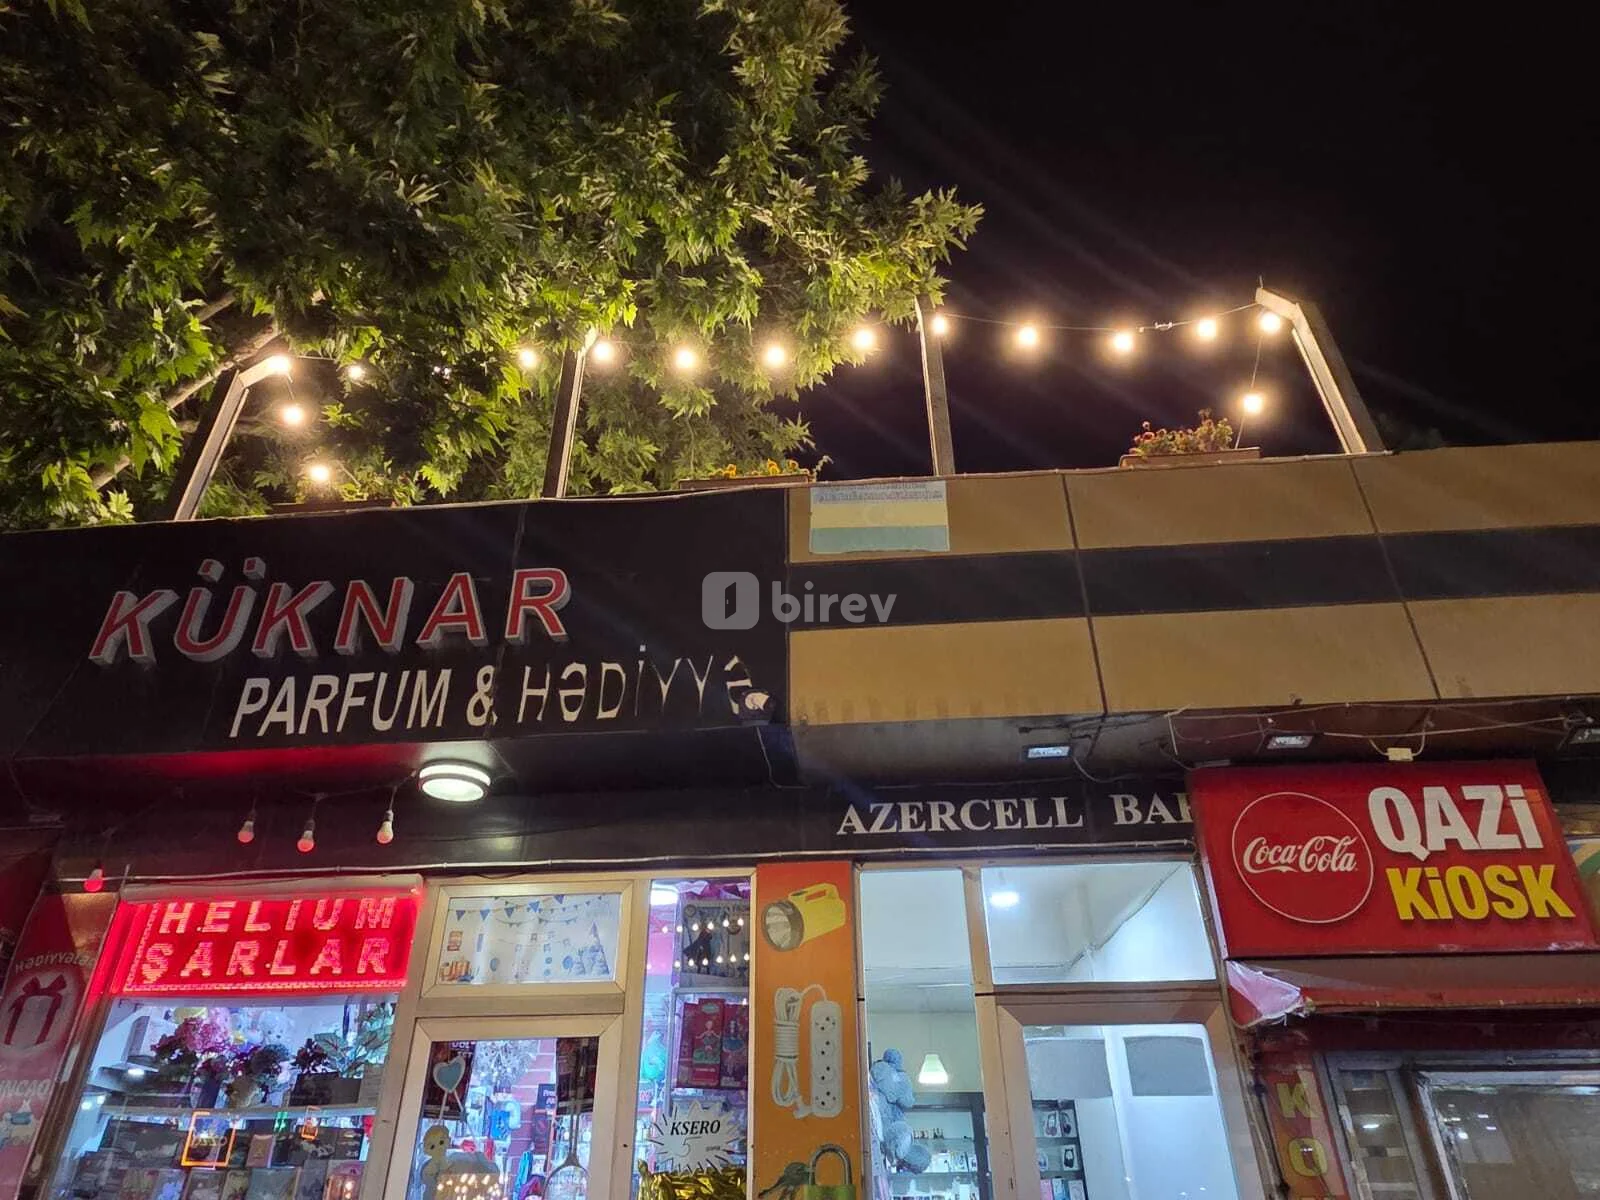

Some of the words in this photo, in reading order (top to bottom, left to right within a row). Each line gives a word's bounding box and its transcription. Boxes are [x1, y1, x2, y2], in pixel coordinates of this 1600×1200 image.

[88, 557, 571, 665] KÜKNAR
[229, 669, 453, 738] PARFUM
[466, 664, 498, 727] &
[836, 797, 1084, 836] AZERCELL
[1242, 835, 1358, 874] Coca-Cola
[158, 897, 397, 934] HELIUM
[141, 937, 390, 985] ŞARLAR
[670, 1119, 721, 1136] KSERO
